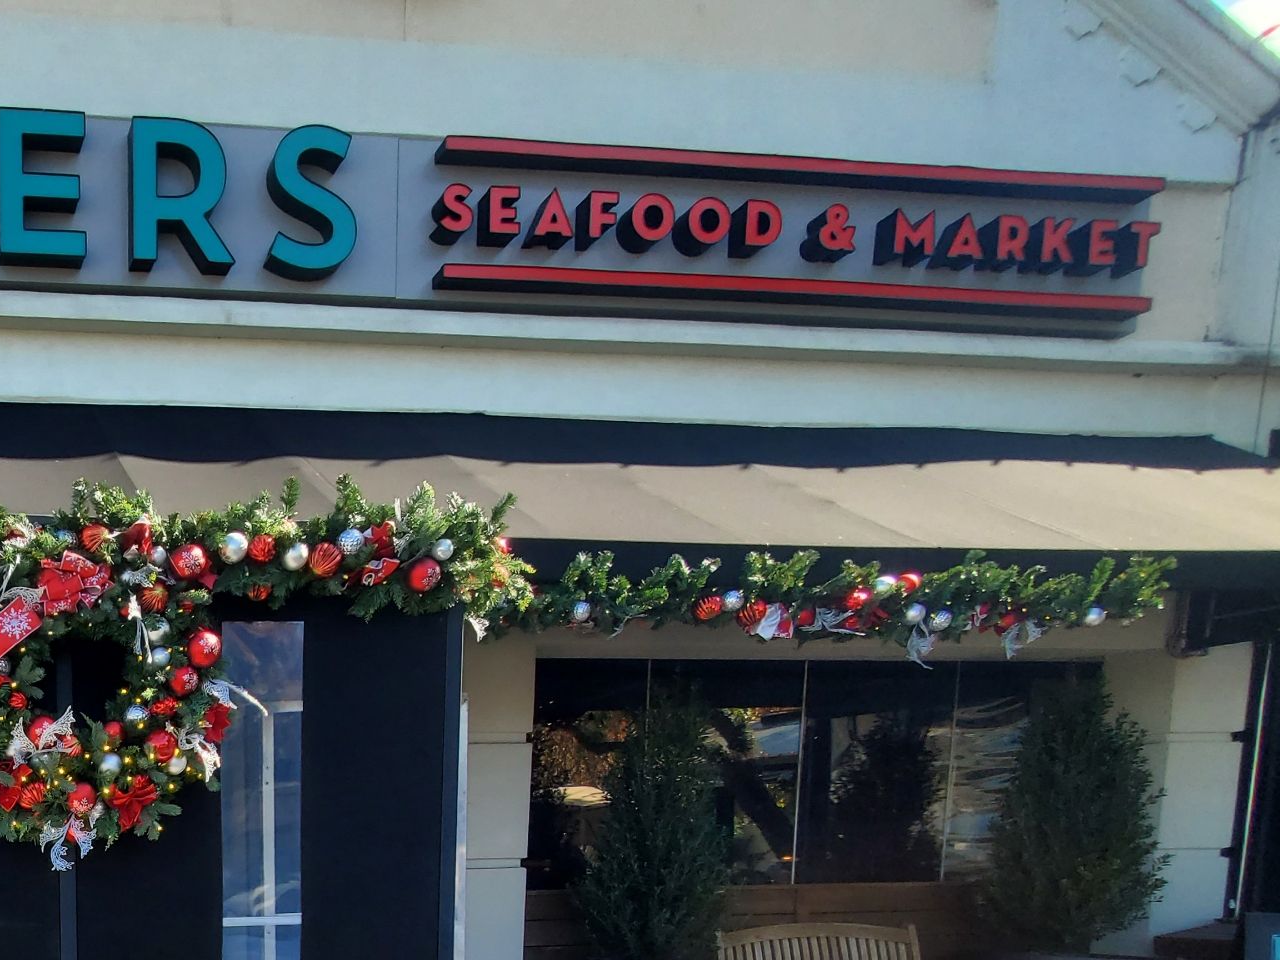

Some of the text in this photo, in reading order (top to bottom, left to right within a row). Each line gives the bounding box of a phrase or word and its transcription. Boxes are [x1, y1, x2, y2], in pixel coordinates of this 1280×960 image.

[433, 182, 1162, 273] SEAFOOD & MARKET
